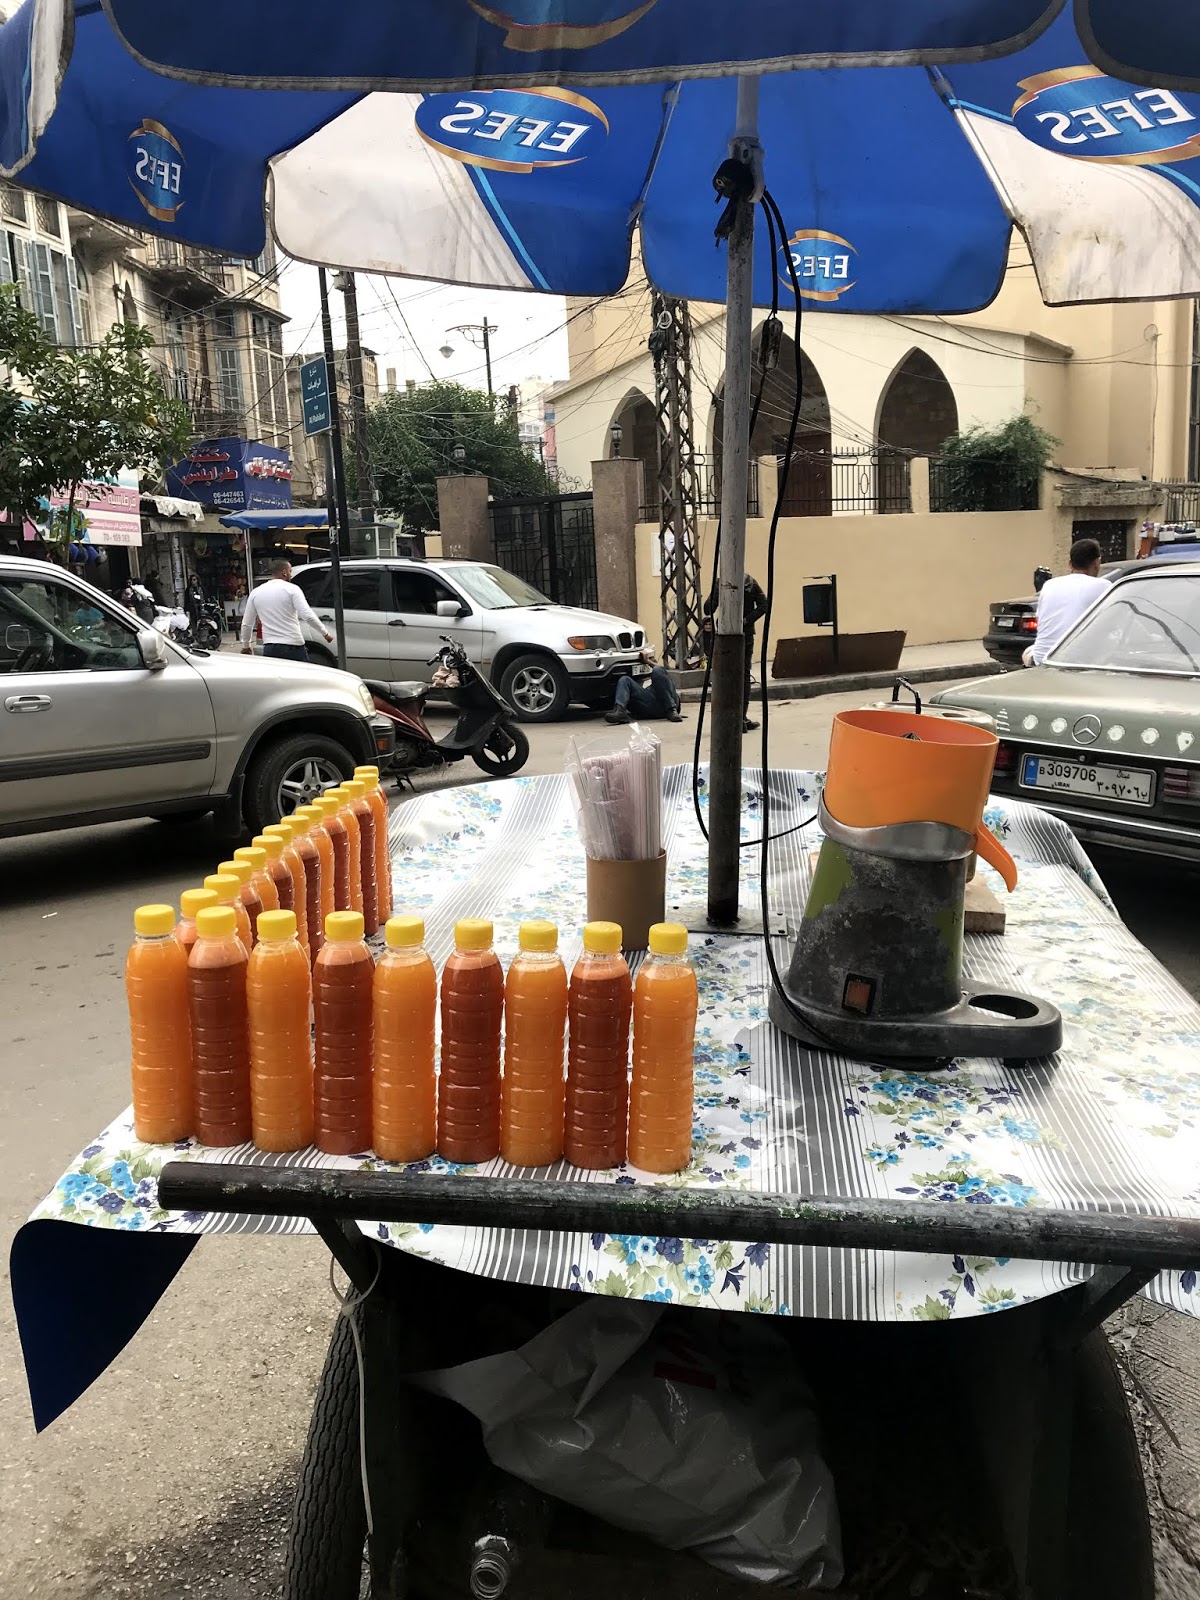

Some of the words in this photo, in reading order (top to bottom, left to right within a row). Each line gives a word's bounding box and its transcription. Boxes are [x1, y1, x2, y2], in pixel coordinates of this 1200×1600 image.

[182, 466, 239, 487] طرابلس
[1039, 766, 1045, 775] B
[1047, 763, 1097, 782] 309706
